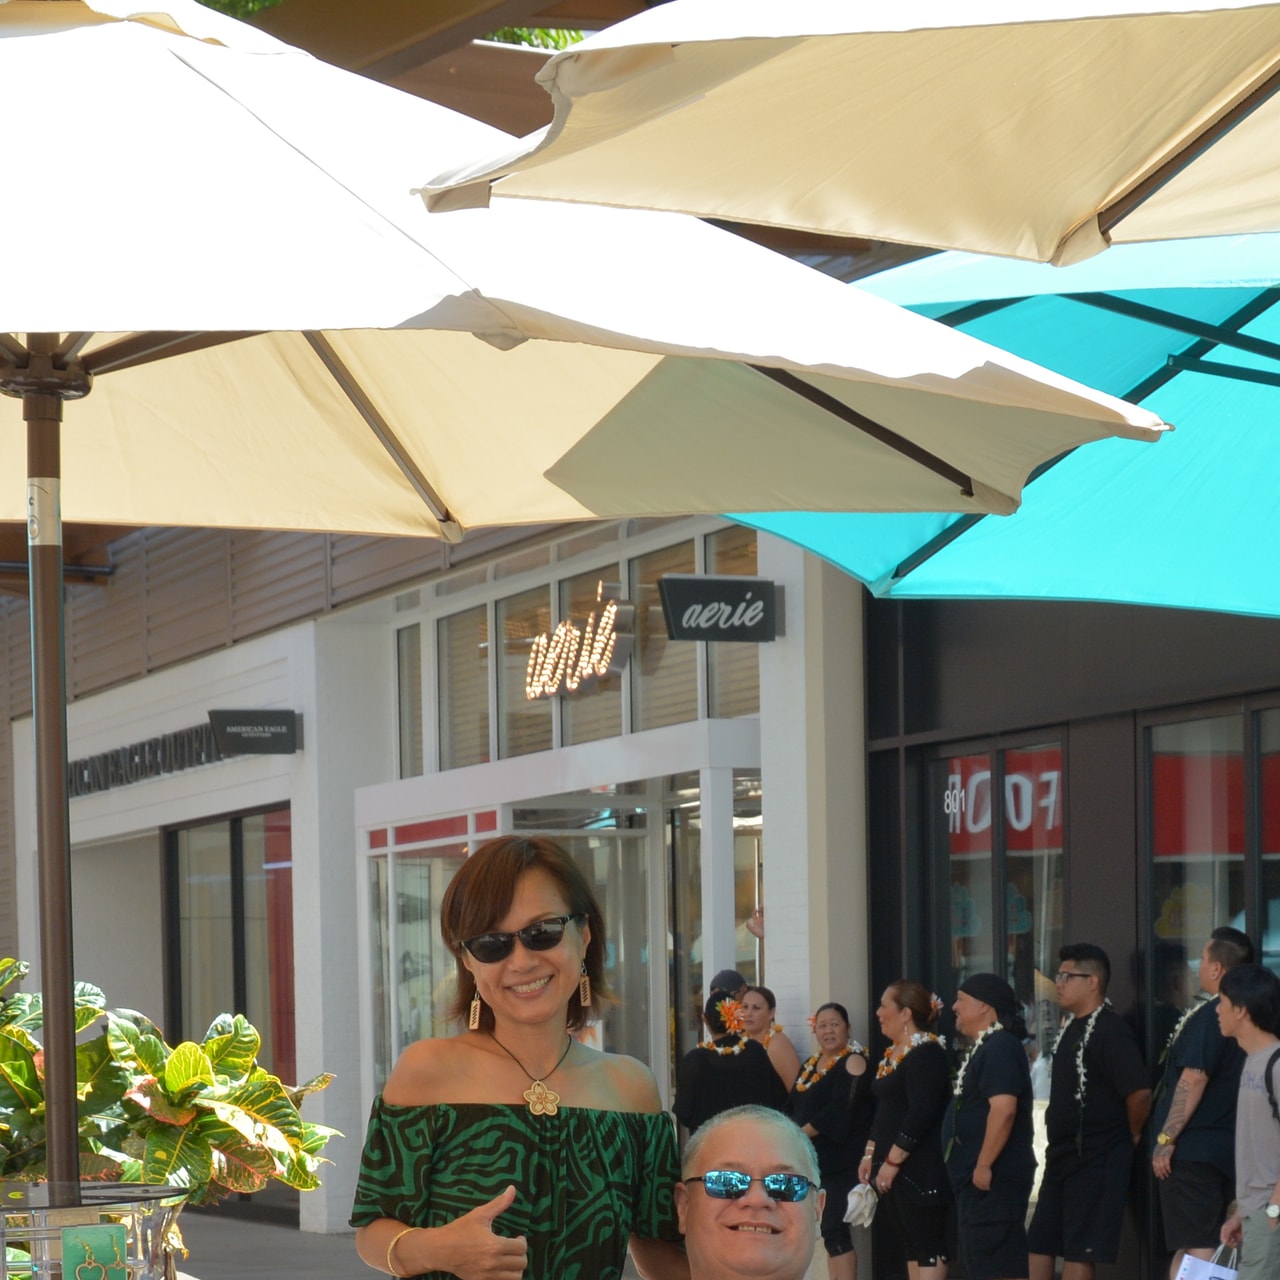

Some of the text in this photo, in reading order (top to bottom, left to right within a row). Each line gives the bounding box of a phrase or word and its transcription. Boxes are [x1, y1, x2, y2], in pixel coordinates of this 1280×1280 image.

[682, 592, 764, 629] aerie
[226, 725, 287, 733] AMERICAN EAGLE
[944, 788, 965, 814] 801
